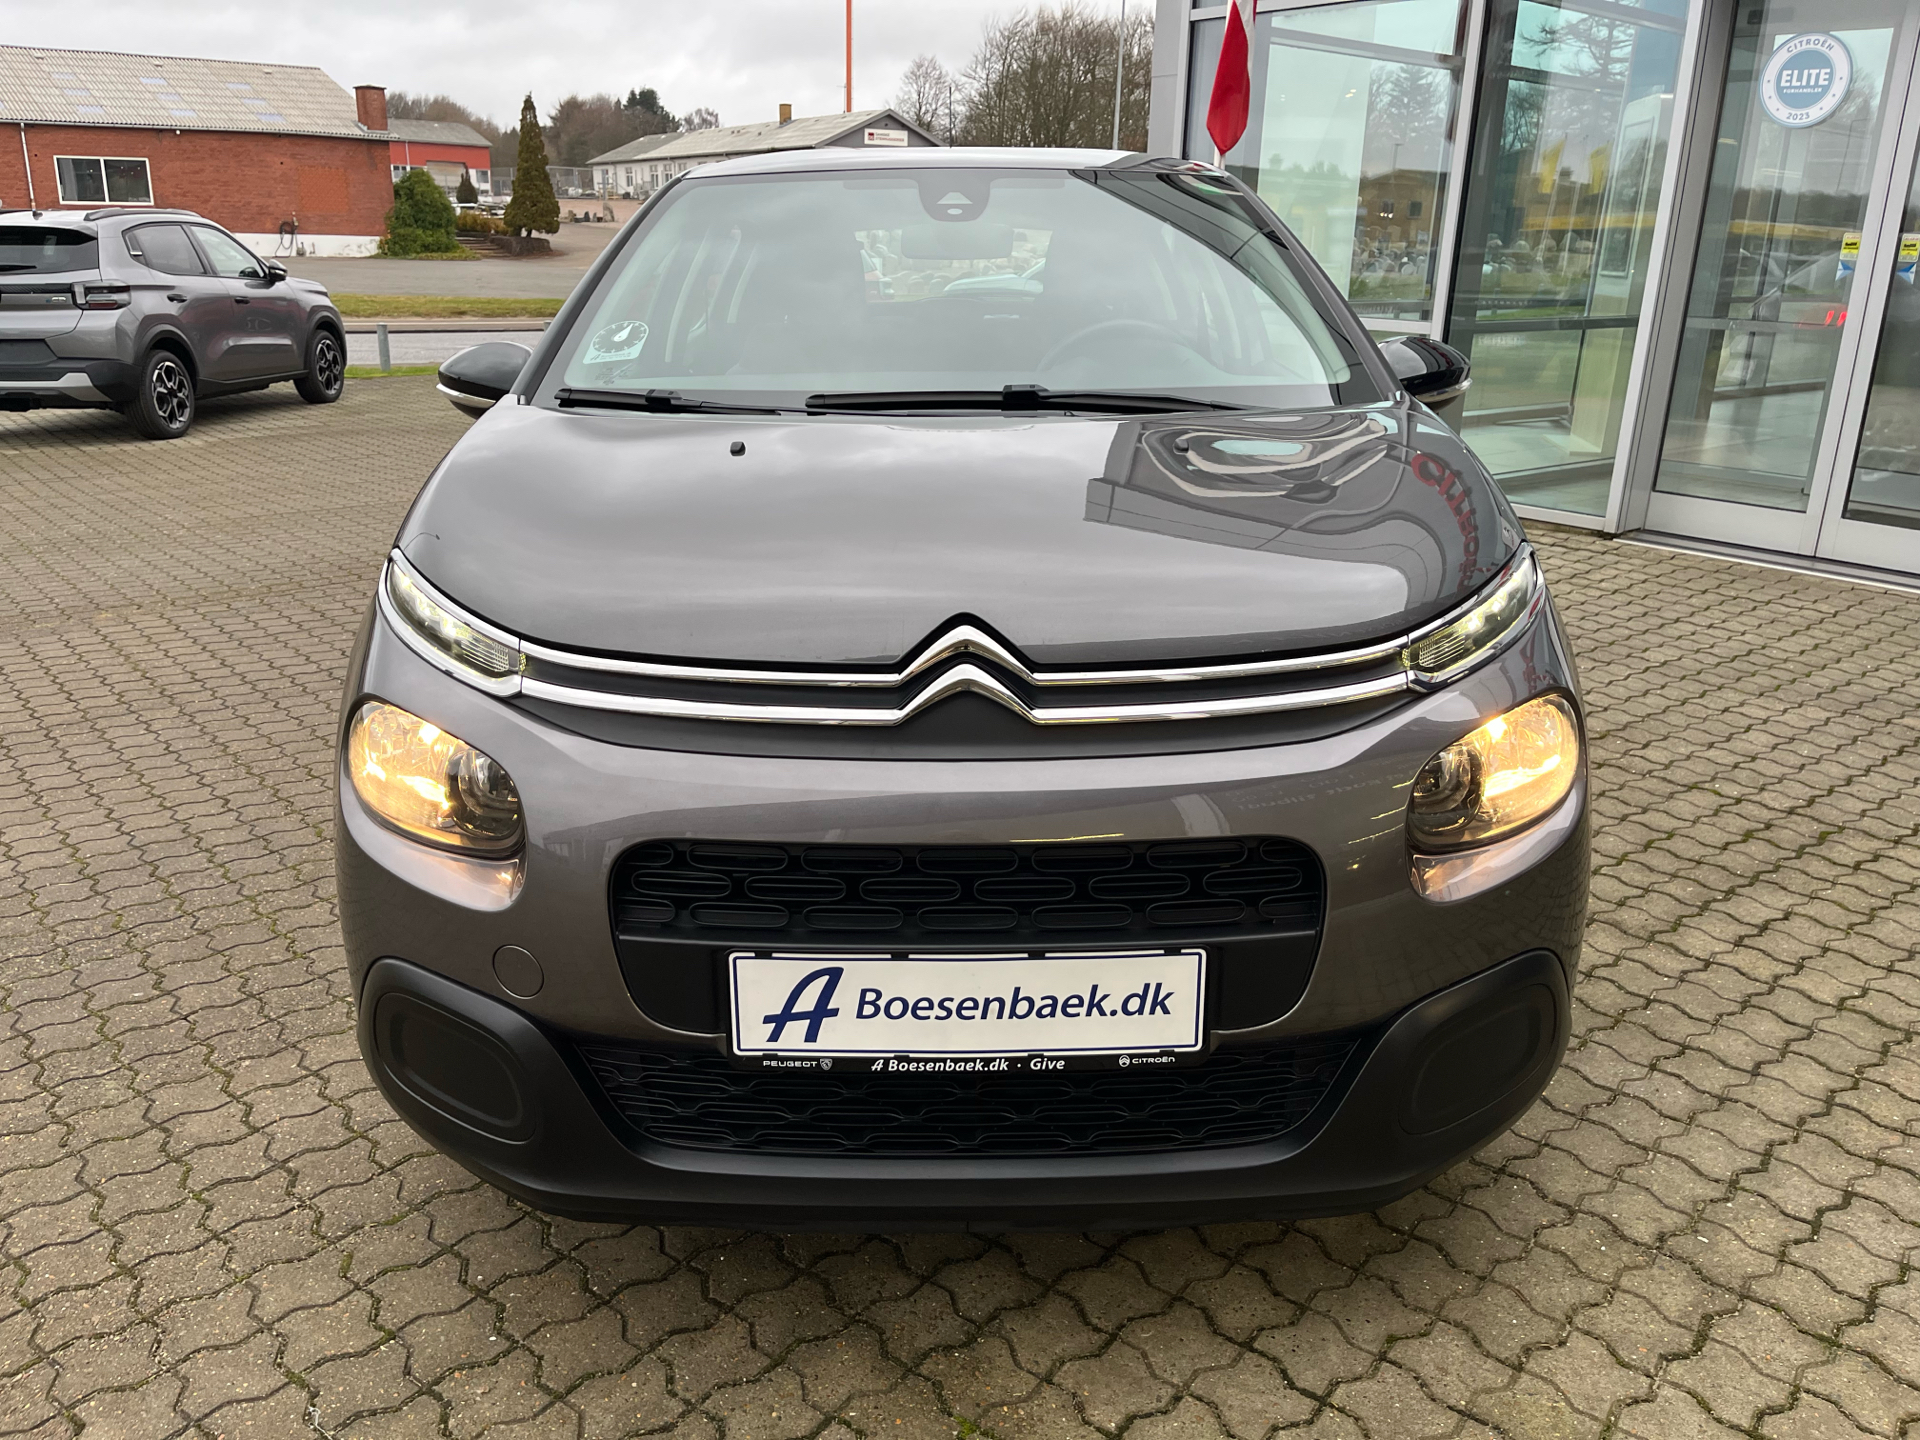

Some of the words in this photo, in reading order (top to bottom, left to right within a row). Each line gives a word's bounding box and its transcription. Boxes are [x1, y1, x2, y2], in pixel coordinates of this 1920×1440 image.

[1786, 37, 1835, 54] CITROËN
[1780, 68, 1831, 87] ELITE
[1786, 111, 1811, 121] 2023
[855, 982, 1175, 1021] Boesenbaek.dk
[762, 1060, 818, 1068] PEUGEOT
[888, 1058, 1010, 1072] Boesenbaek.dk
[1029, 1057, 1066, 1070] Give
[1131, 1055, 1176, 1064] CITROËN
